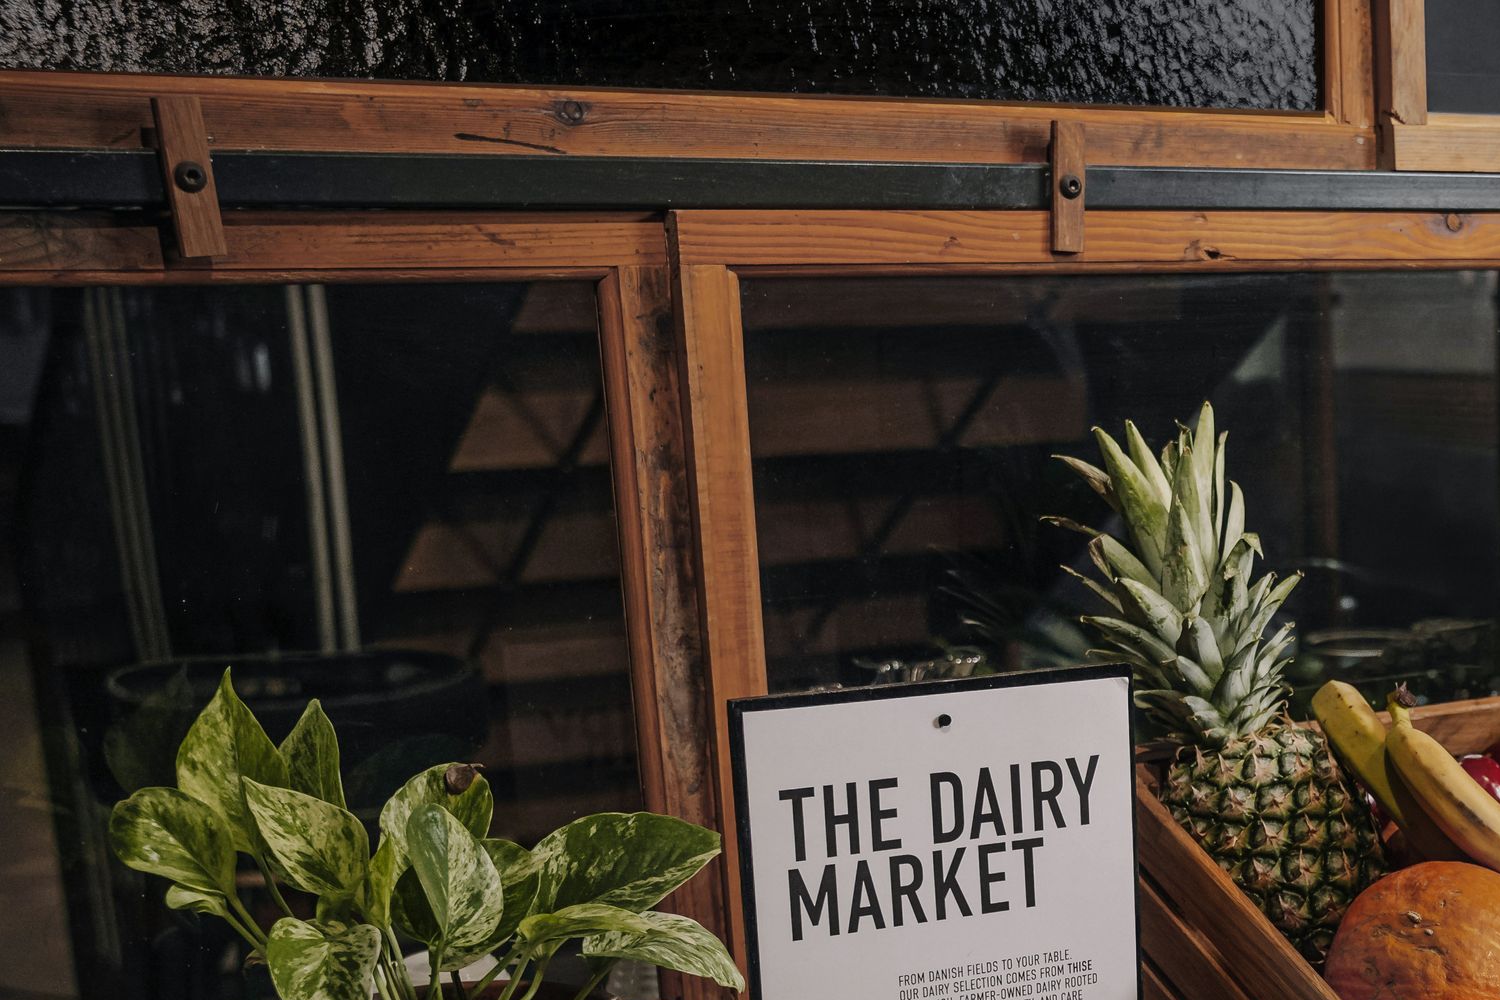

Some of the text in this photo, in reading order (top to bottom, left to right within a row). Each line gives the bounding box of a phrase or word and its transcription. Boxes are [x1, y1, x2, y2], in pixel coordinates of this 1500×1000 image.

[779, 754, 1100, 862] THE DAIRY
[787, 837, 1045, 941] MARKET
[898, 949, 1072, 987] FROM DANISH FIELDS TO YOUR TABLE.
[900, 960, 1092, 1000] OUR DAIRY SELECTION COMES FROM THISE
[1036, 980, 1062, 993] DAIRY
[1064, 972, 1098, 988] ROOTED
